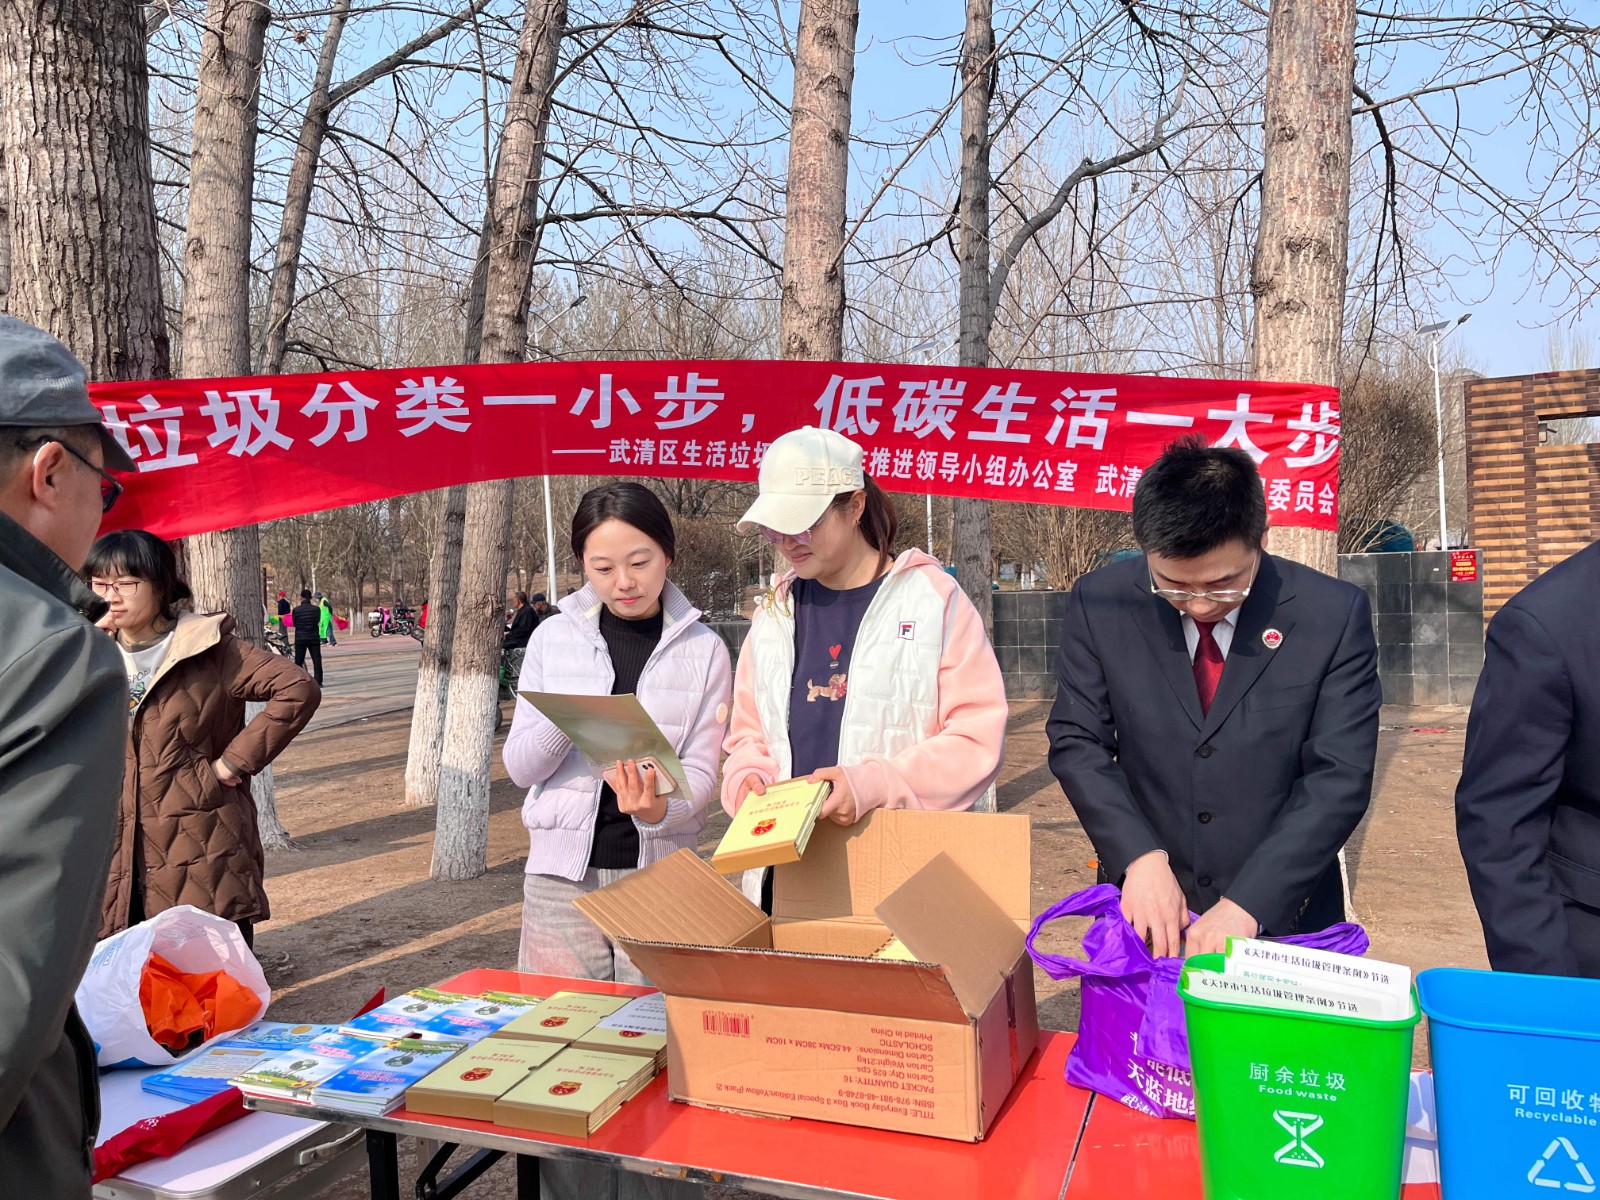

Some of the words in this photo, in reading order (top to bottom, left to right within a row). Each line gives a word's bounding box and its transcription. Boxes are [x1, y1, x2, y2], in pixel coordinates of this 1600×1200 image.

[871, 1027, 893, 1037] China
[895, 1030, 903, 1038] in
[904, 1031, 933, 1042] Printed
[795, 1039, 817, 1049] 38CM
[879, 1039, 933, 1052] SCHOLASTIC
[906, 1052, 934, 1062] Carton
[872, 1068, 887, 1077] 625
[906, 1062, 934, 1073] Carton
[843, 1075, 852, 1083] 16
[888, 1069, 905, 1080] Qty:
[906, 1072, 934, 1083] Carton
[1250, 1062, 1346, 1091] 厨余垃圾
[854, 1076, 899, 1089] QUANTITY:
[901, 1082, 935, 1094] PACKET
[725, 1085, 744, 1094] (Pack
[1259, 1084, 1293, 1096] Food
[1295, 1090, 1337, 1102] waste
[797, 1094, 825, 1105] Special
[826, 1098, 832, 1106] 3
[833, 1099, 848, 1108] Box
[912, 1099, 935, 1109] ISBN:
[850, 1101, 870, 1111] Book
[871, 1102, 908, 1116] Everyday
[910, 1109, 935, 1120] TITLE:
[1515, 1107, 1597, 1127] Recyclable
